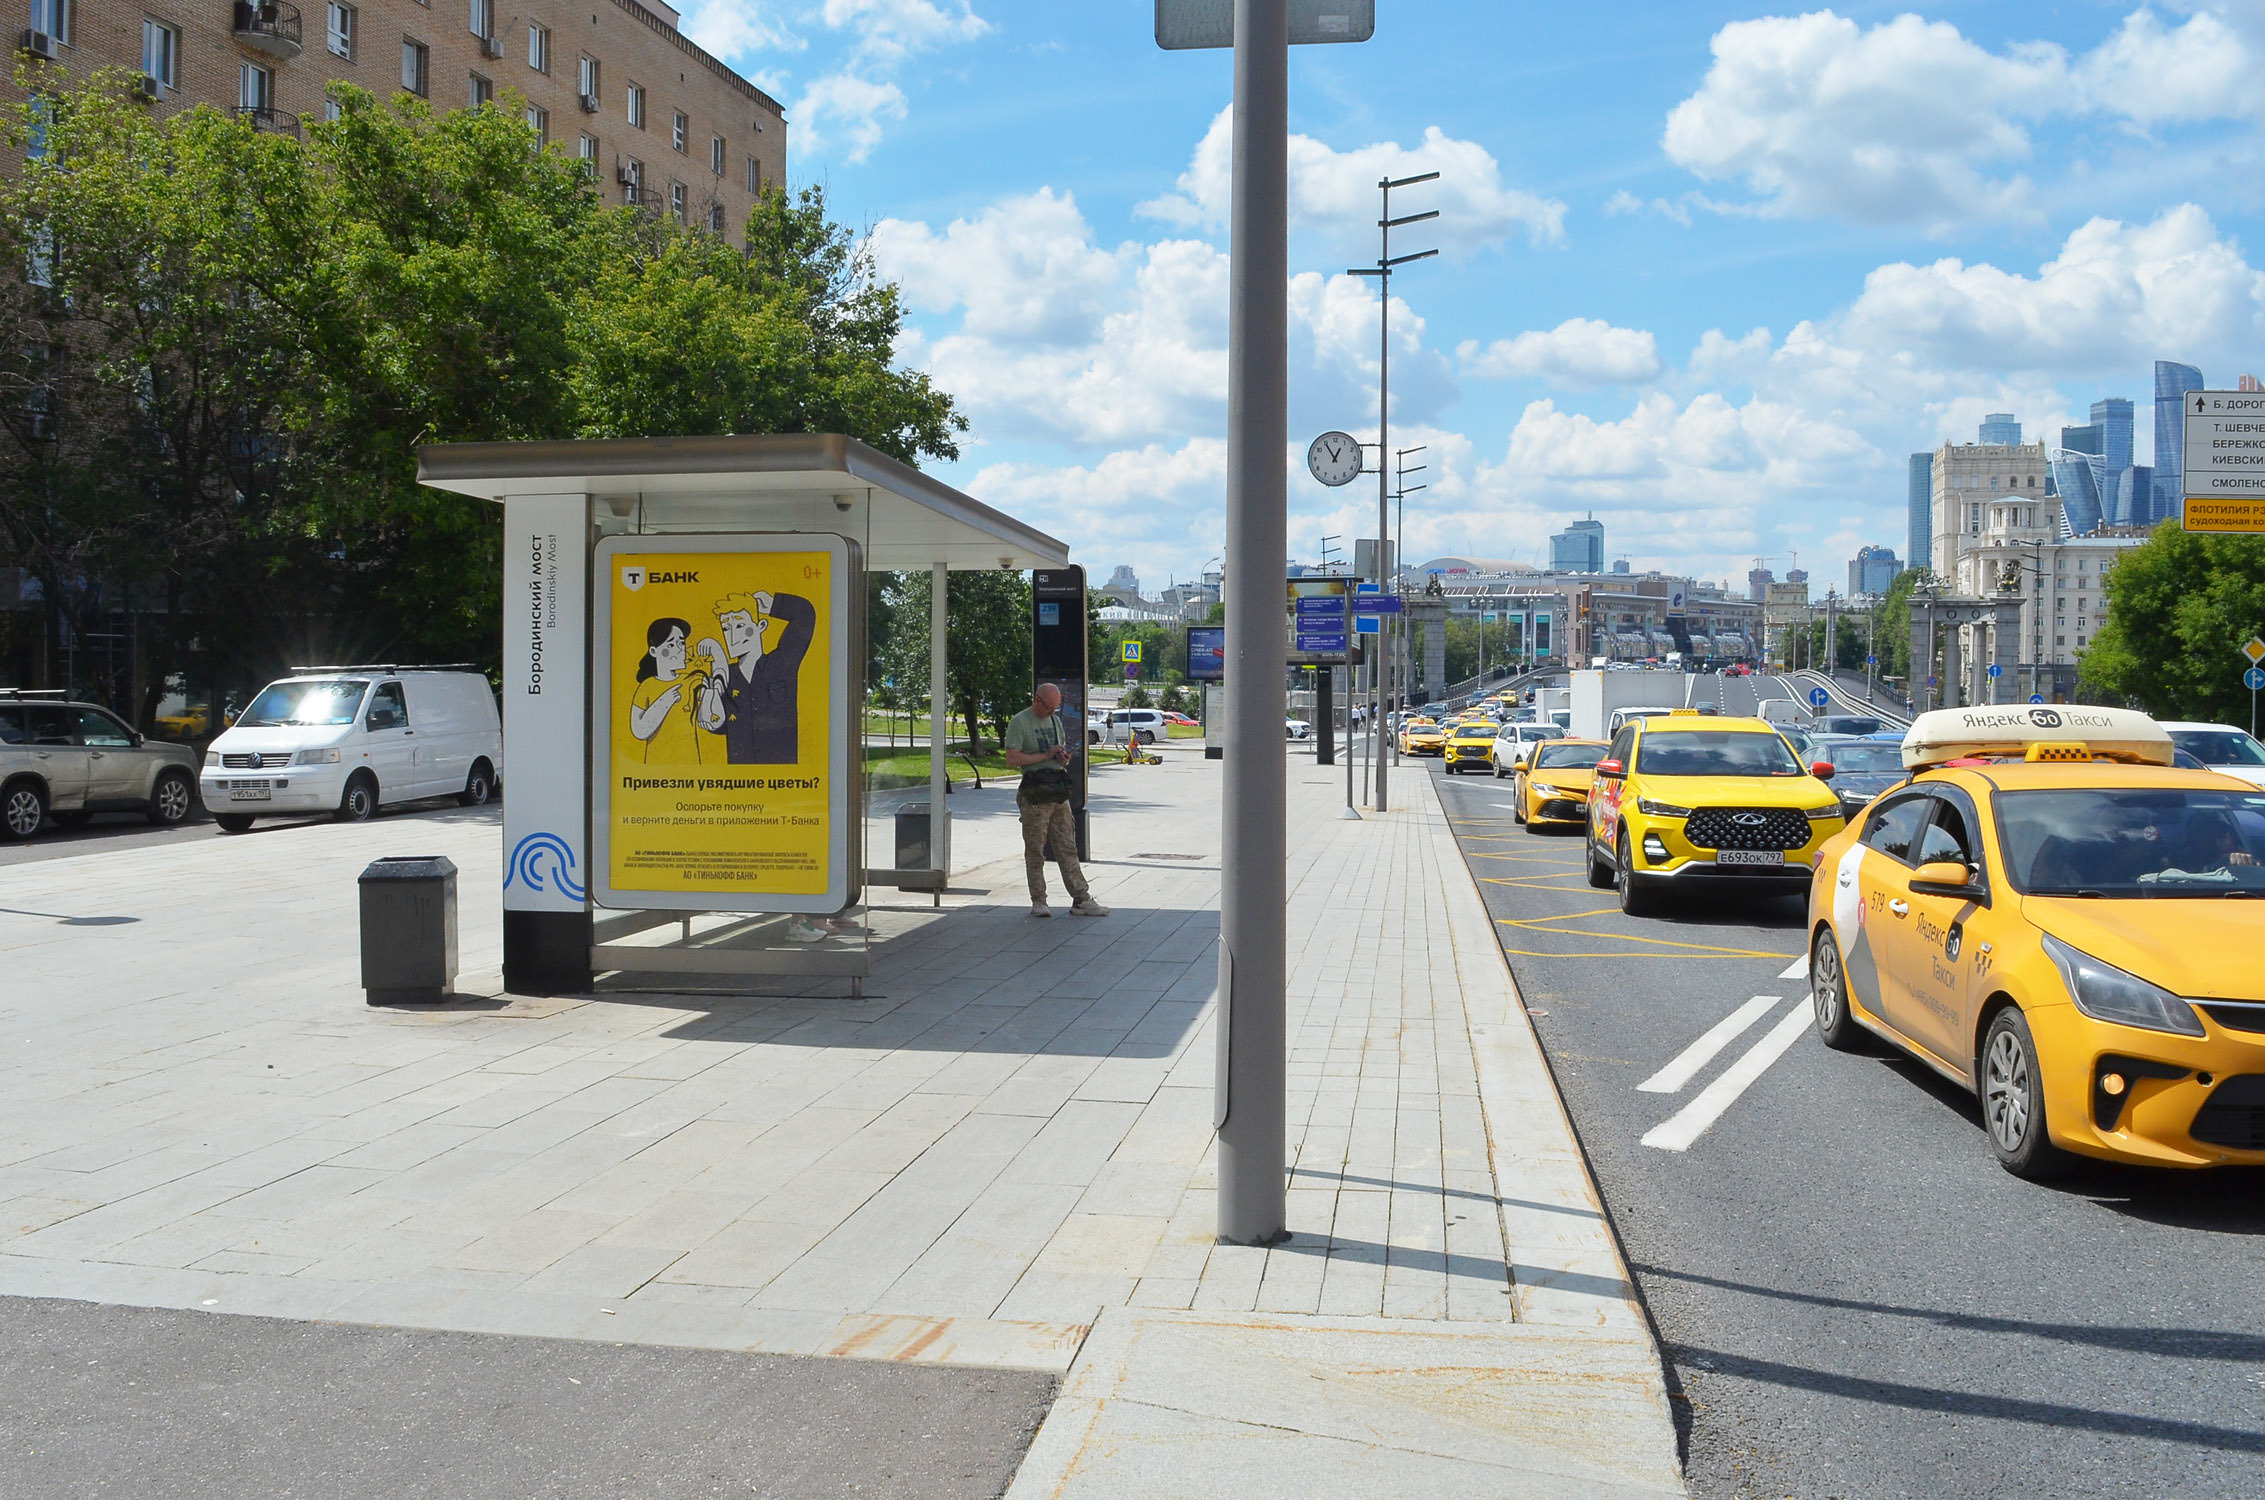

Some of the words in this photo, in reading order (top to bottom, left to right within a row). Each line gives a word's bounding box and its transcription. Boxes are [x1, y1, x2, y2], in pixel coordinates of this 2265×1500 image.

[2214, 400, 2224, 409] Б.
[2227, 400, 2265, 410] ДОРОГ
[2214, 423, 2222, 432] Т.
[2225, 423, 2265, 433] ШЕВЧЕ
[2212, 455, 2265, 465] КИЕВСКИ
[2190, 505, 2250, 514] ФЛОТИЛИЯ
[2190, 517, 2250, 526] судоходная
[547, 534, 557, 561] Most
[531, 534, 542, 576] мост
[649, 571, 700, 584] БАНК
[803, 565, 822, 580] 0+
[547, 564, 558, 628] Borodinskiy
[1042, 605, 1056, 613] 239
[528, 582, 544, 695] Бородинский
[1963, 713, 2027, 728] Яндекс
[2063, 712, 2113, 727] Такси
[623, 776, 695, 791] Привезли
[697, 778, 765, 791] увядшие
[768, 776, 820, 790] цветы?
[676, 802, 723, 813] Оспорьте
[724, 803, 764, 813] покупку
[631, 816, 671, 826] верните
[672, 817, 706, 825] деньги
[708, 817, 714, 825] в
[716, 816, 779, 827] приложении
[781, 816, 820, 825] Т-Банка
[683, 870, 692, 880] АО
[694, 870, 735, 880] «ТИНЬКОФФ
[736, 871, 758, 881] БАНК»
[1871, 890, 1886, 913] 579
[1916, 911, 1946, 947] Яндекс
[1946, 929, 1961, 956] Go
[1932, 955, 1956, 991] Такси
